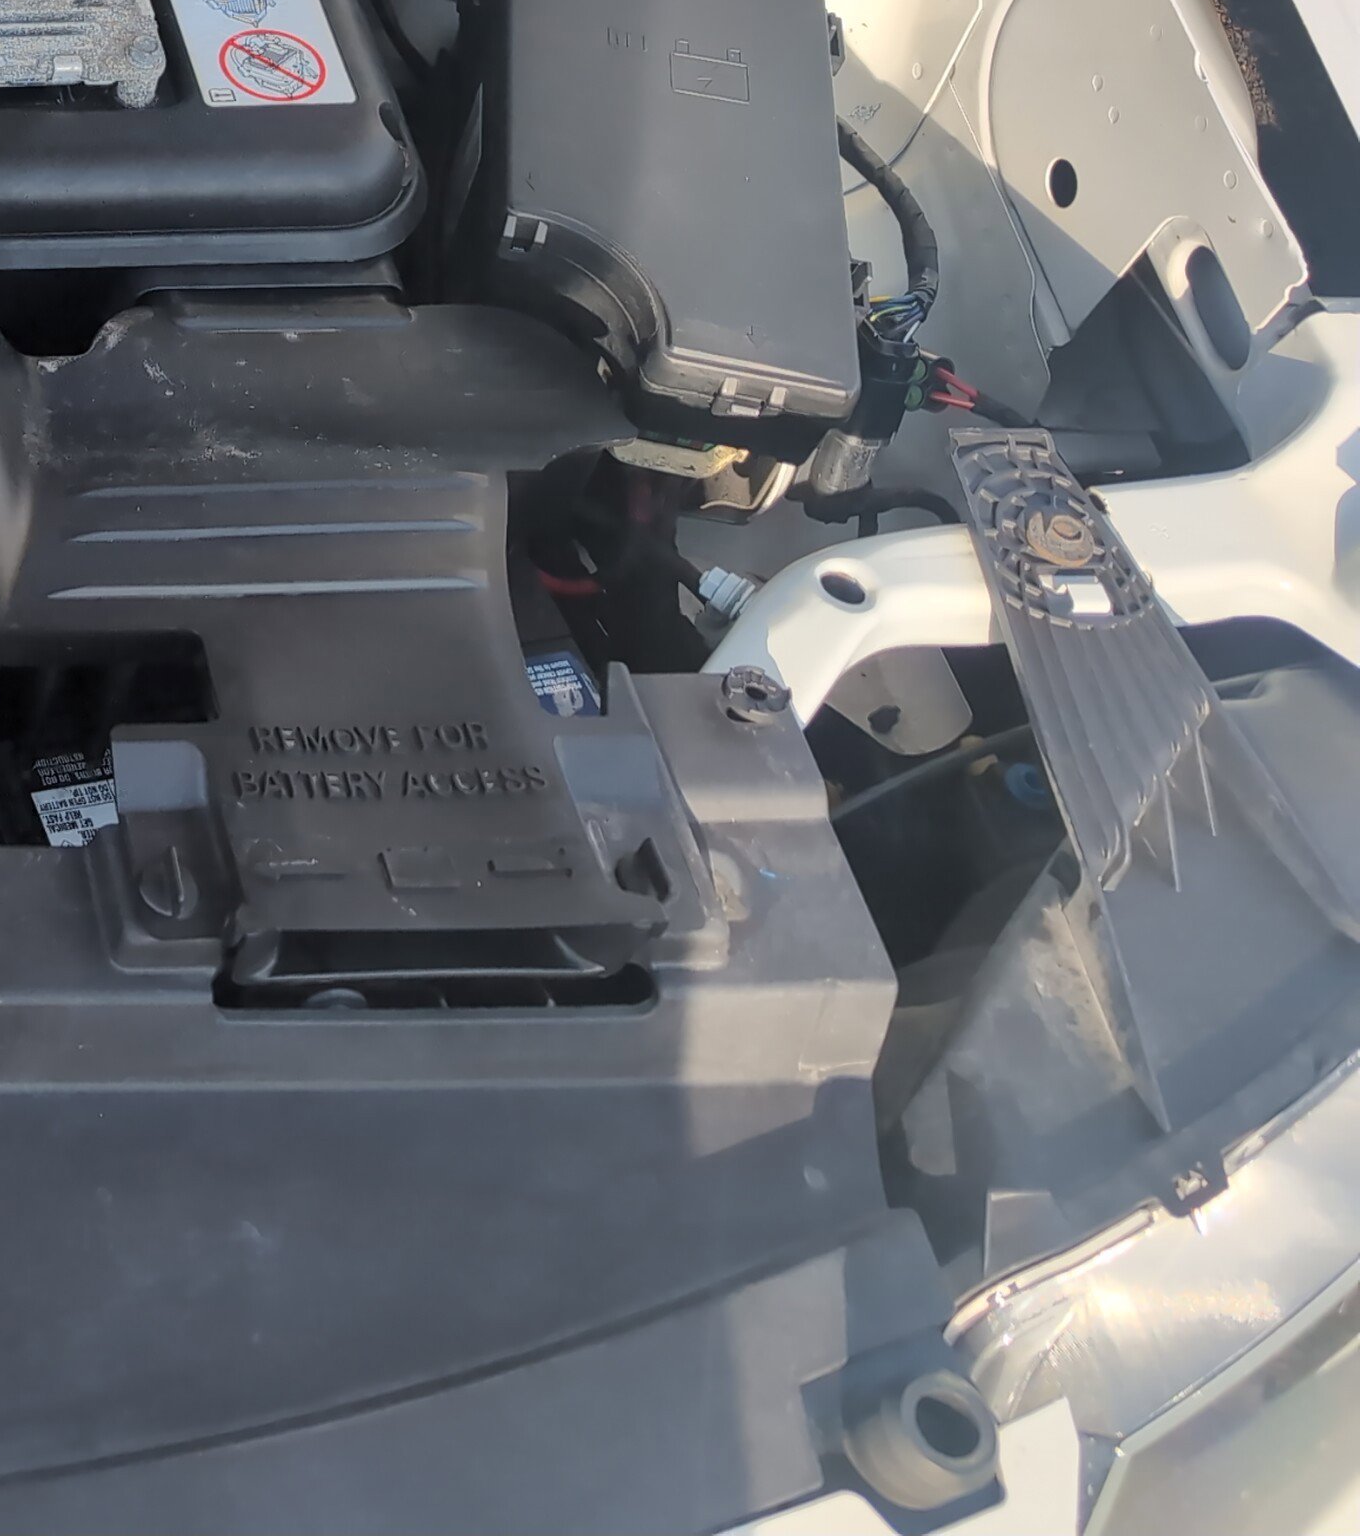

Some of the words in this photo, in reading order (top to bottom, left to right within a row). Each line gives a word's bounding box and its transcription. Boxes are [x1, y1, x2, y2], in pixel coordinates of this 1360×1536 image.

[249, 724, 401, 753] REMOVE
[413, 721, 491, 750] FOR
[233, 768, 391, 800] BATTERY
[401, 765, 549, 797] ACCESS
